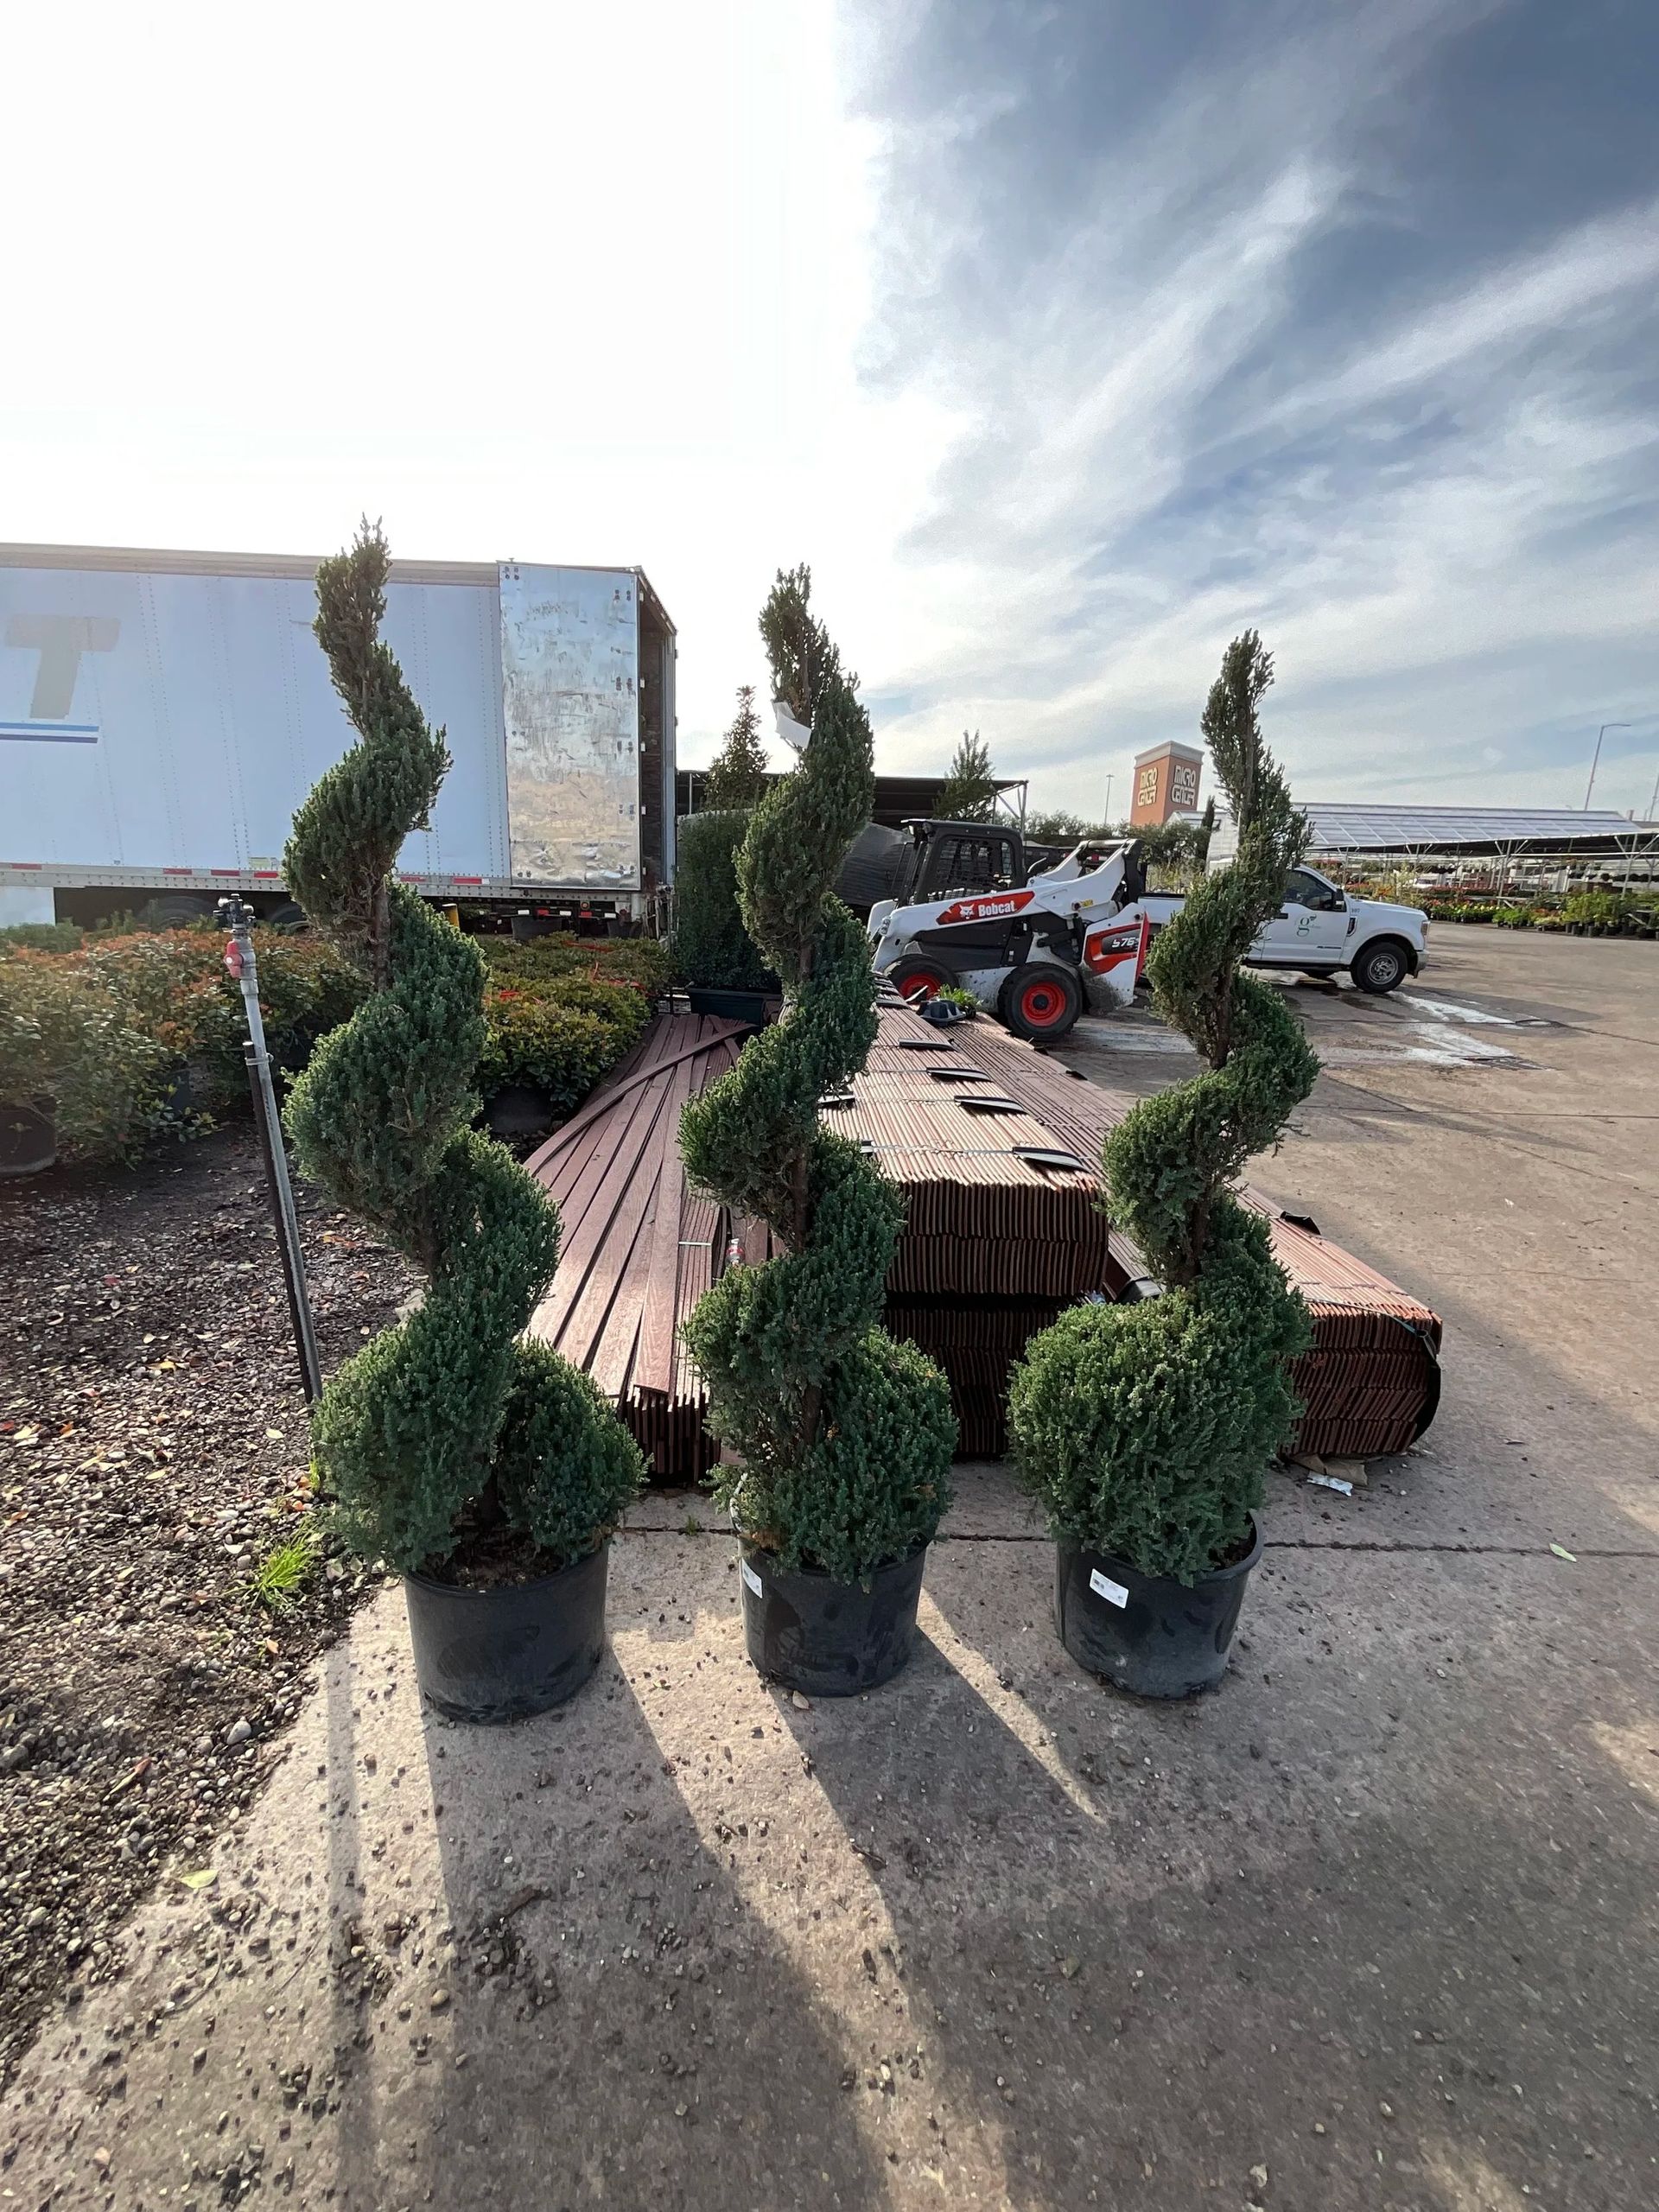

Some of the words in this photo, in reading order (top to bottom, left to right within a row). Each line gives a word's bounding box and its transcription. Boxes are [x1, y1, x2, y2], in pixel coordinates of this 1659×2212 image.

[1140, 767, 1158, 789] MICRO
[1174, 765, 1197, 787] MICRO
[1137, 785, 1157, 807] CENTER
[1171, 784, 1196, 806] CENTER
[977, 899, 1015, 917] Bobcat
